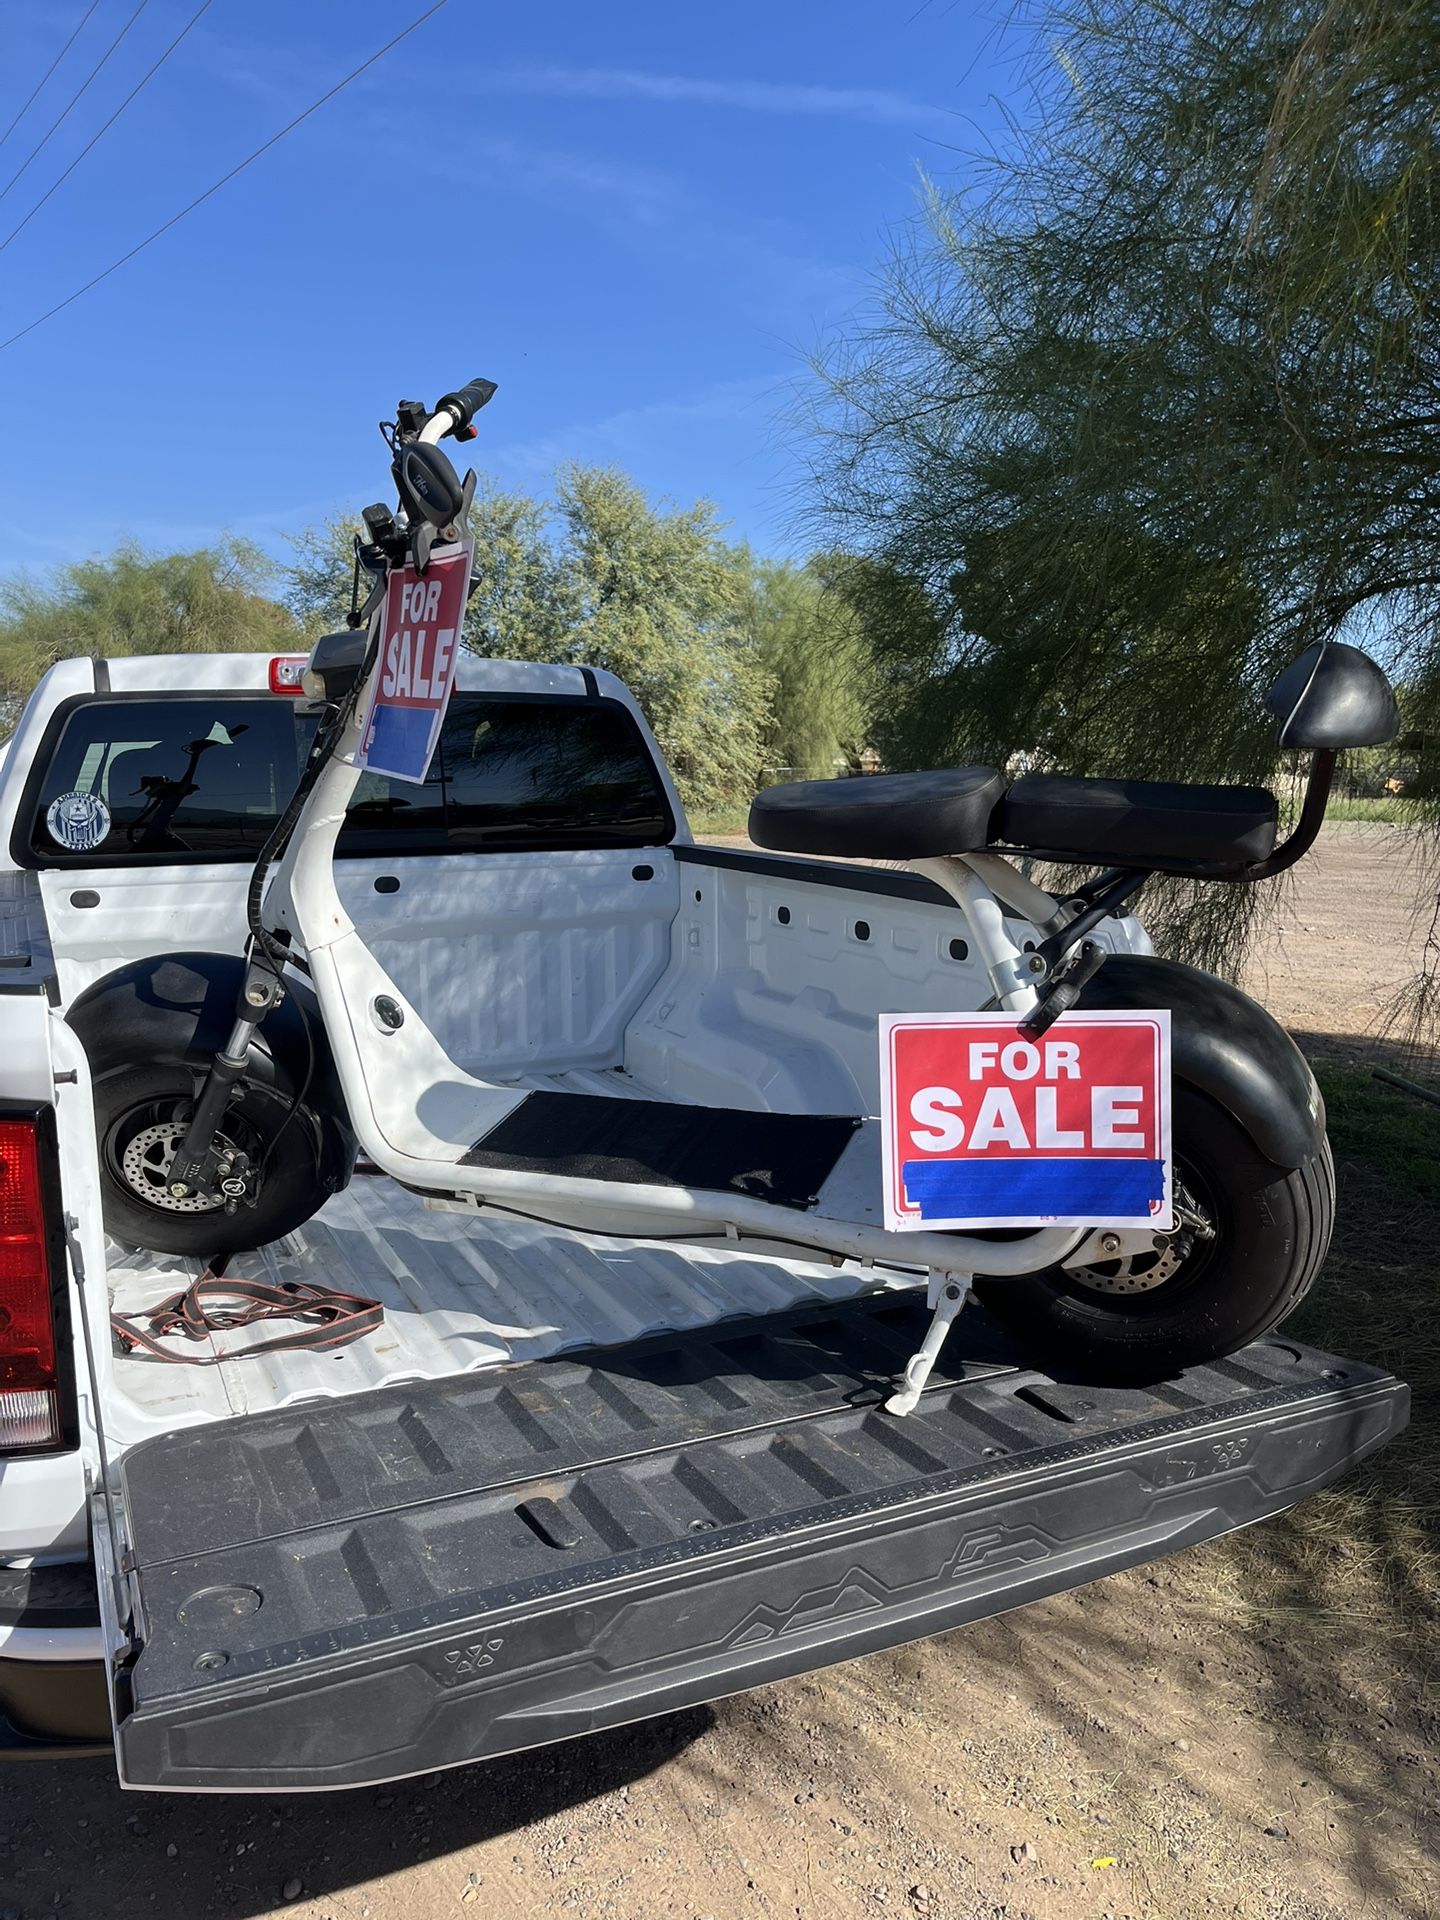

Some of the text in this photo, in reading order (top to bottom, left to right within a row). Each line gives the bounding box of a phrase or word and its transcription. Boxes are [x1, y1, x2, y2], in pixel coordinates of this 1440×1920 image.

[401, 581, 442, 622] FOR
[383, 628, 454, 698] SALE
[968, 1041, 1082, 1082] FOR
[909, 1085, 1146, 1152] SALE
